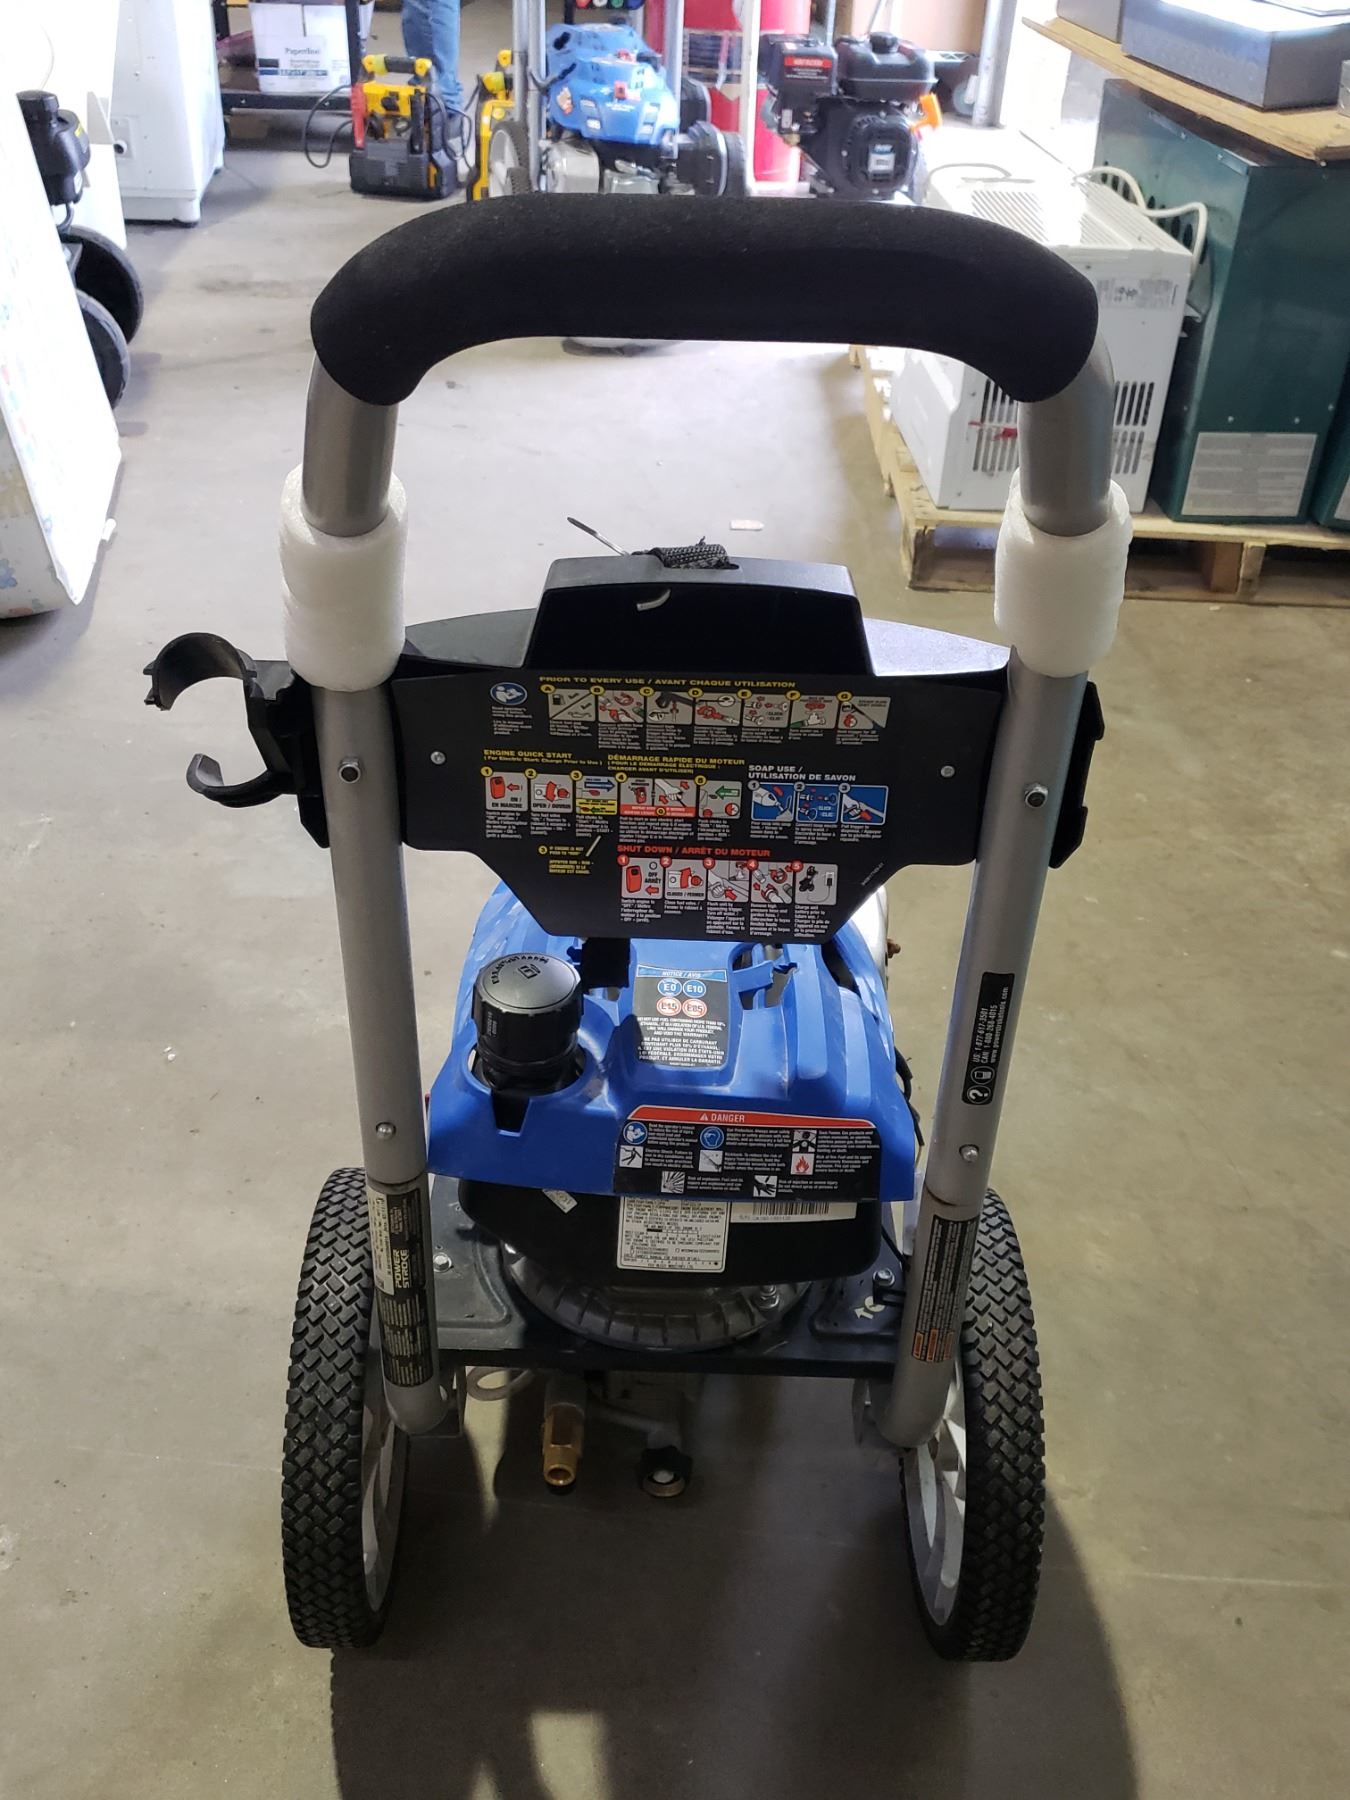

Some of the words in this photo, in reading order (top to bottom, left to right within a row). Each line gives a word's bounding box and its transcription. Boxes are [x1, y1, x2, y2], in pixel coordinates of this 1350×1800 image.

[607, 754, 660, 762] DÉMARRAGE
[681, 846, 711, 855] ARRÊT
[664, 983, 676, 992] E0
[686, 984, 703, 993] E10
[980, 1052, 990, 1064] CAN
[710, 1114, 745, 1122] DANGER
[402, 1248, 410, 1289] STROKE
